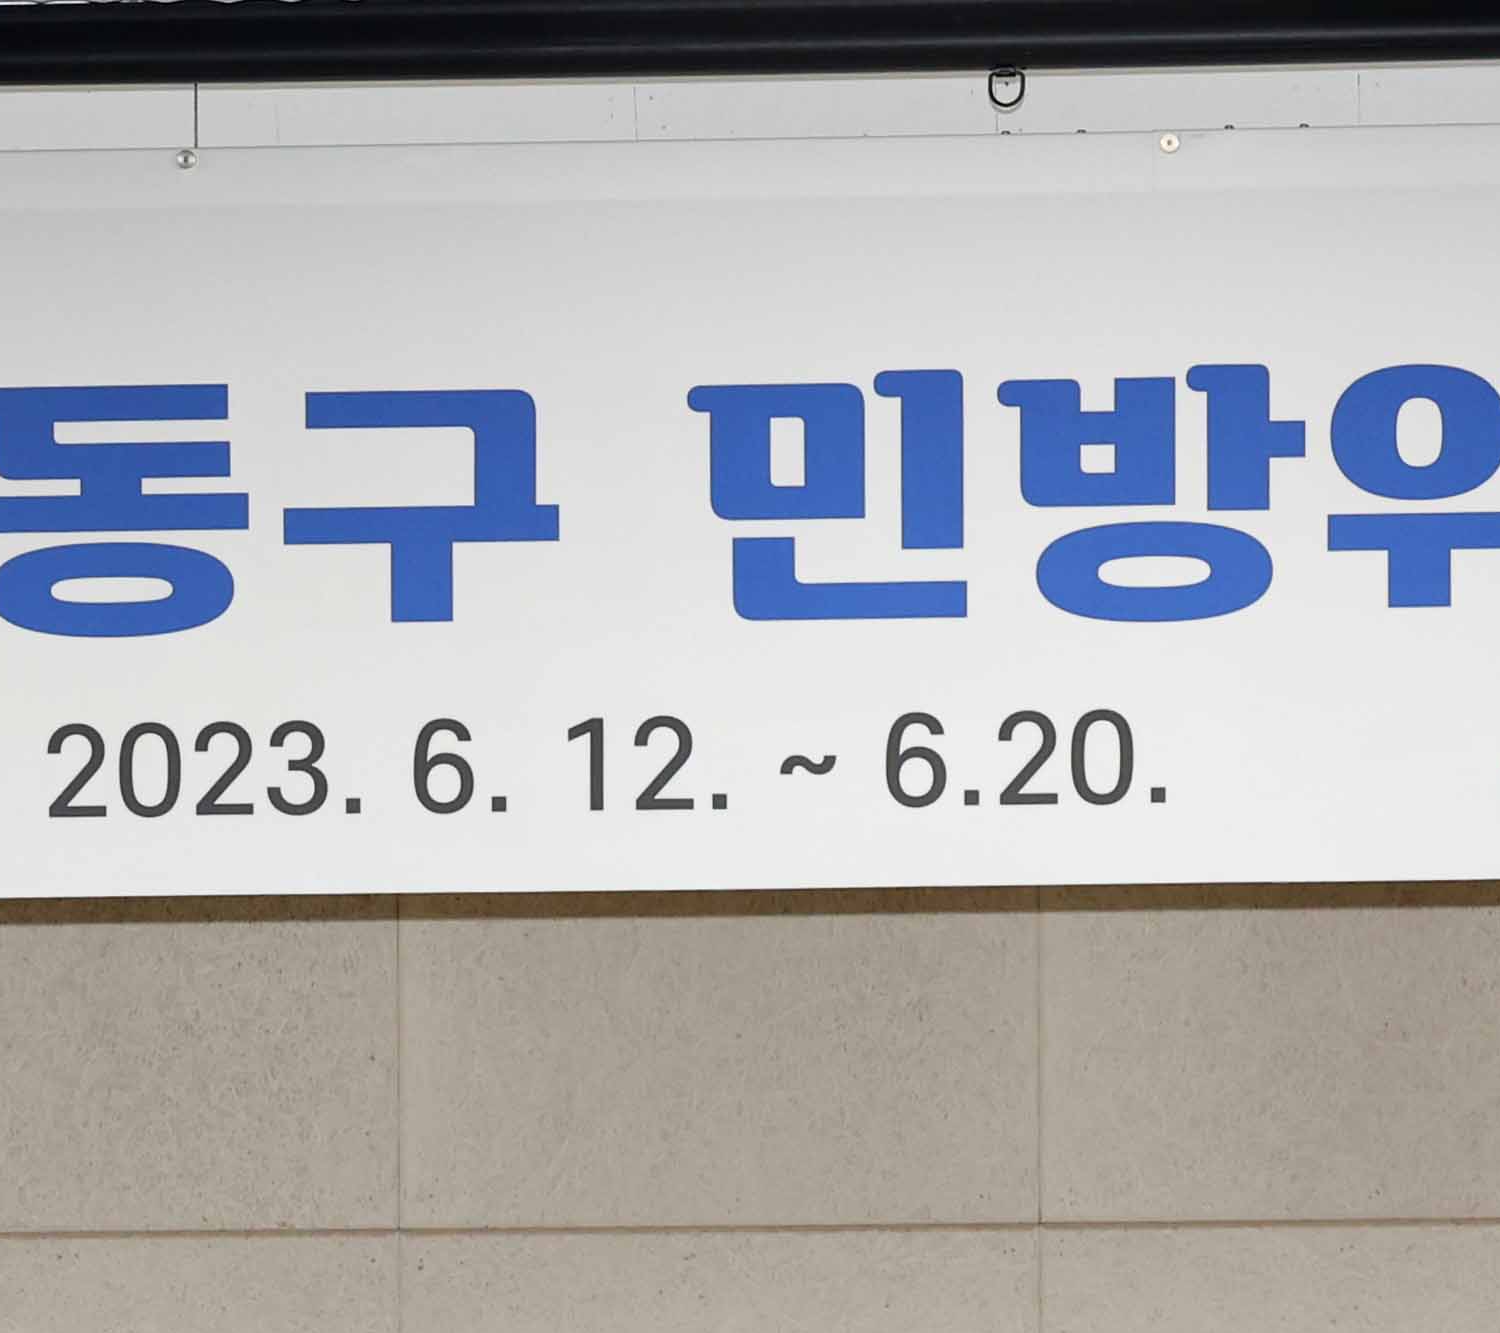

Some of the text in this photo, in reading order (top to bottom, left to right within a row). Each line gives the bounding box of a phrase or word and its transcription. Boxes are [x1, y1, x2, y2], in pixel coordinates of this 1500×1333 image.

[46, 719, 362, 819] 2023.
[412, 717, 508, 816] 6.
[566, 714, 729, 812] 12.
[884, 708, 1167, 809] 6.20.
